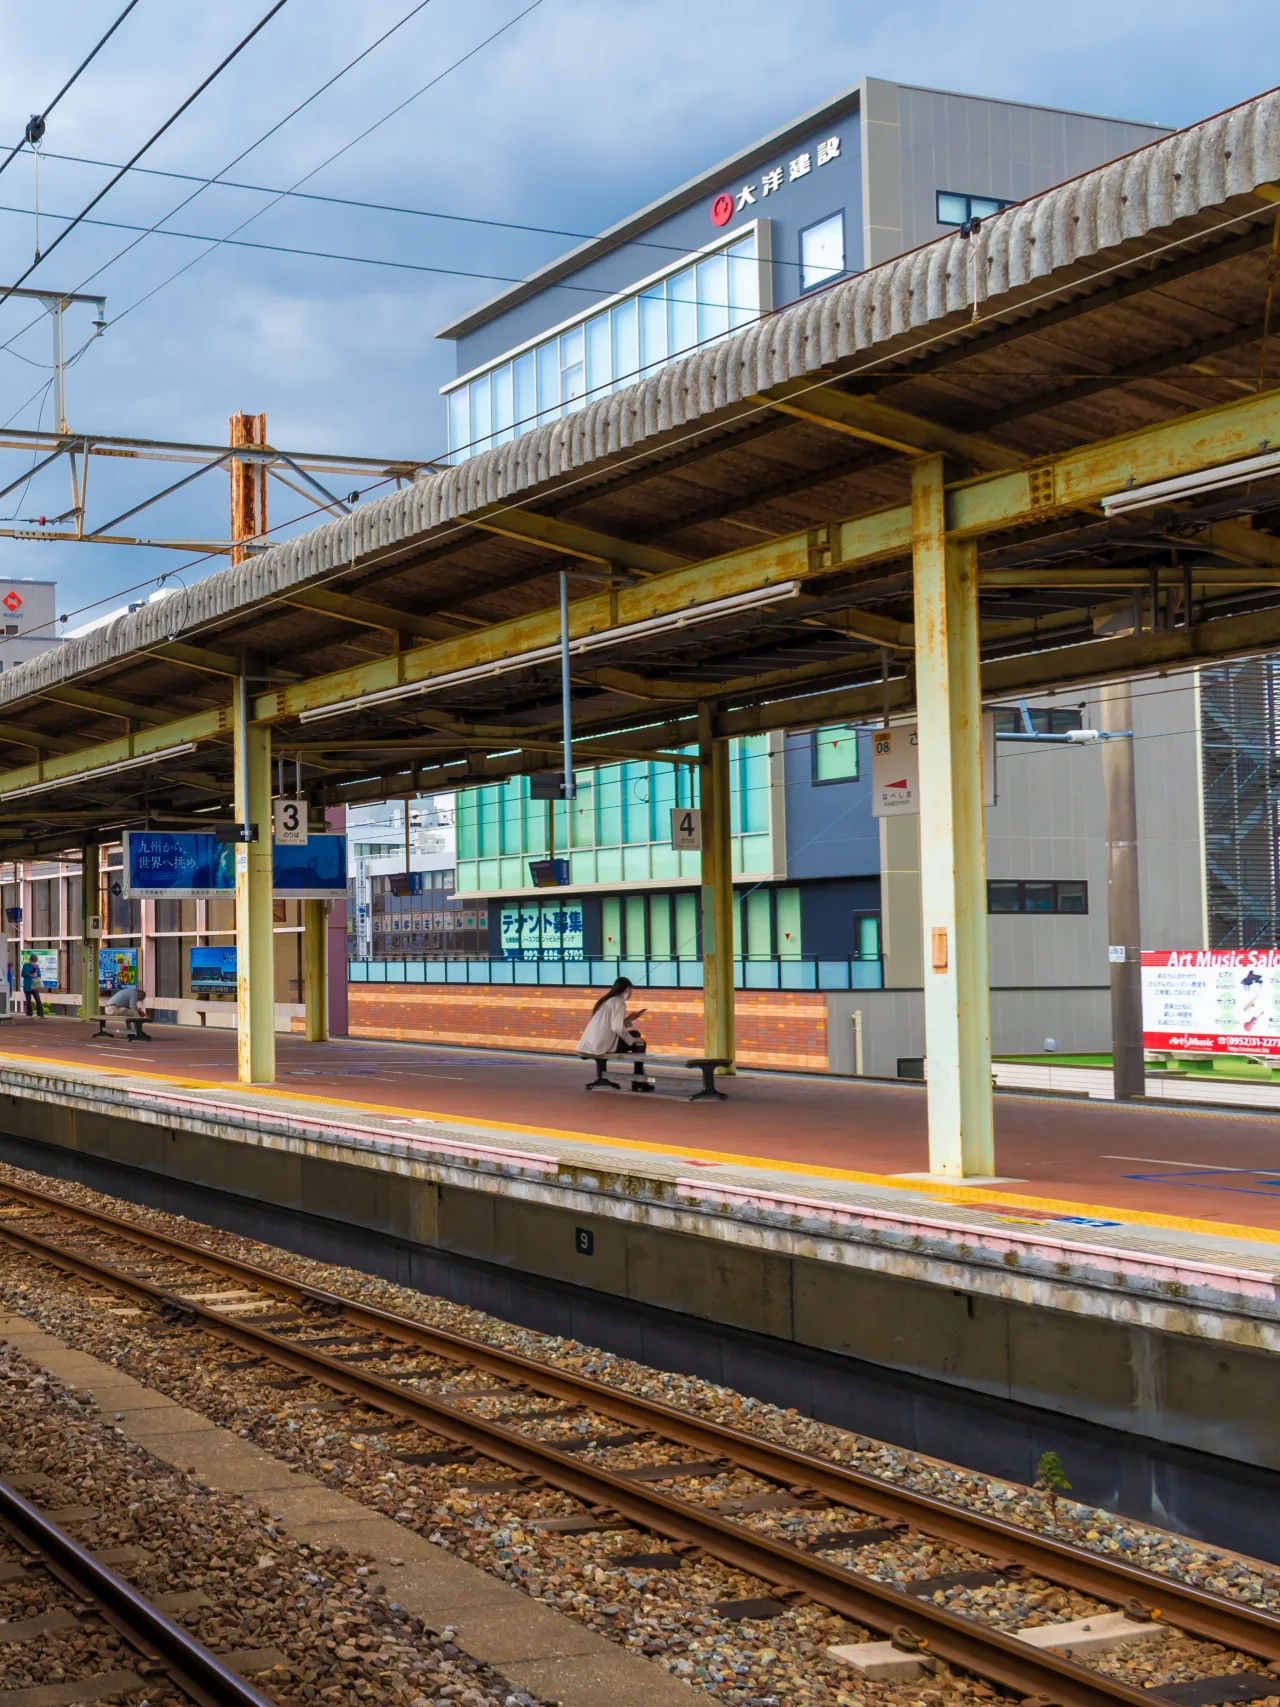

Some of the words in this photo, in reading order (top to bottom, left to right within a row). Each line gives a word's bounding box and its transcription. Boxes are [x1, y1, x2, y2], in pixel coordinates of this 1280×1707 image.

[735, 135, 840, 212] 大洋建設
[877, 741, 890, 754] 08
[282, 804, 299, 831] 3
[680, 812, 695, 837] 4
[283, 831, 300, 839] のりば
[139, 840, 187, 854] 九州から、
[138, 856, 200, 869] 世界へ挑め。
[502, 910, 583, 935] テナント募集
[1167, 951, 1193, 967] Art
[1195, 950, 1245, 967] Music
[580, 1232, 588, 1249] 9
